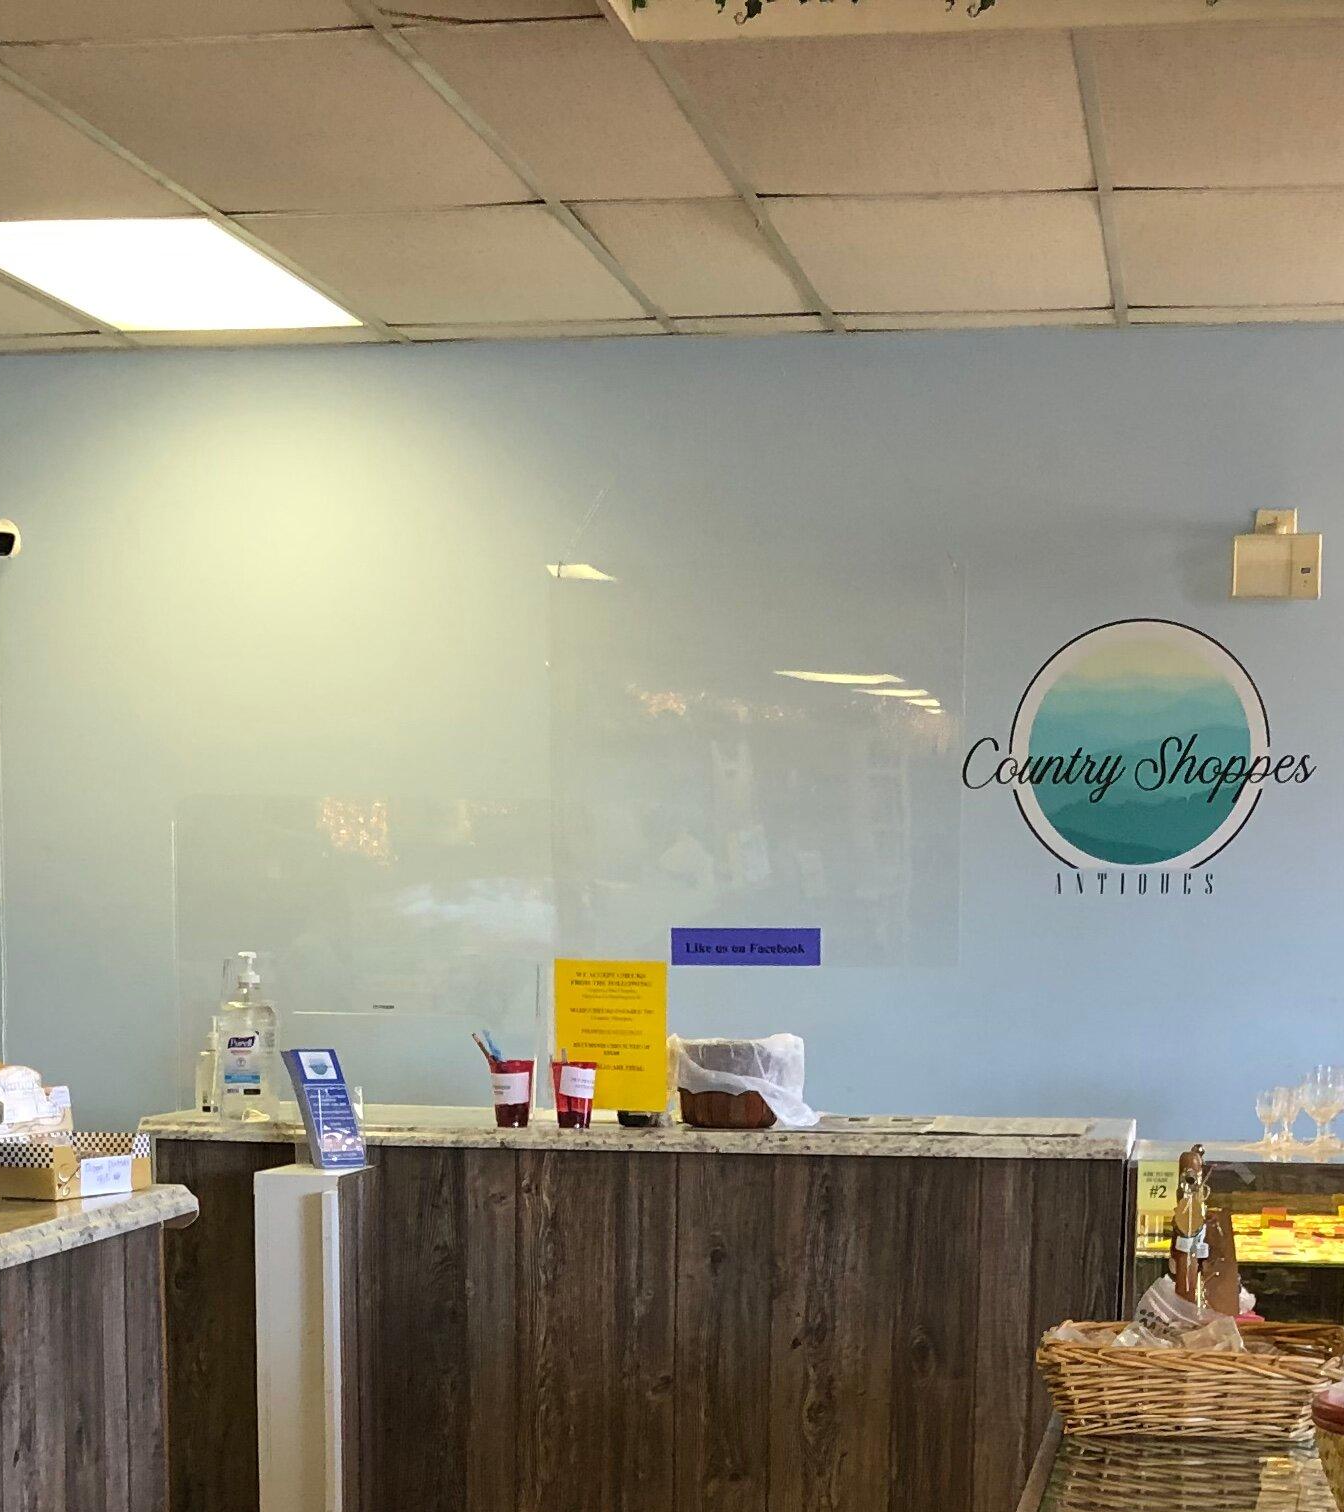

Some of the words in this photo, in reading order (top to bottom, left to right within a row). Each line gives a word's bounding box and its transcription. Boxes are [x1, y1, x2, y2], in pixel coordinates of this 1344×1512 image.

[962, 737, 1126, 804] Country
[1134, 734, 1317, 804] Shoppes
[685, 942, 711, 955] Like
[715, 944, 728, 955] us
[731, 944, 746, 955] on
[750, 942, 805, 955] Facebook
[1149, 1185, 1167, 1199] #2
